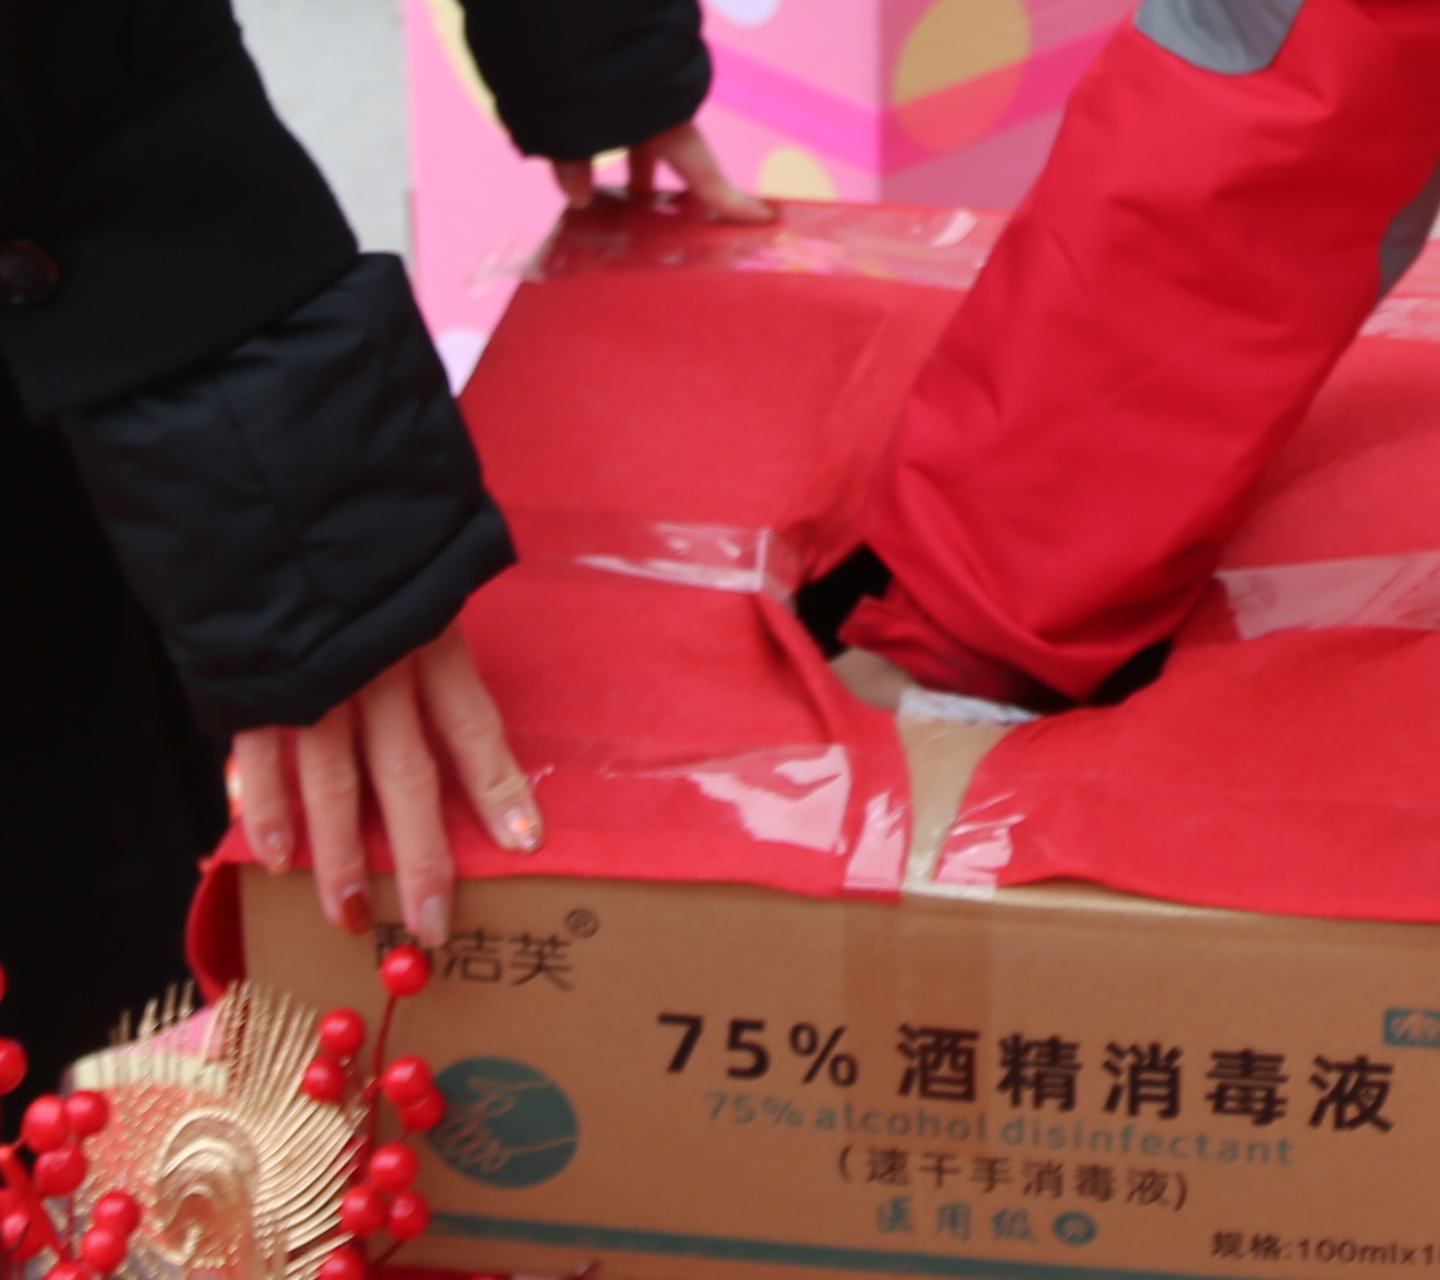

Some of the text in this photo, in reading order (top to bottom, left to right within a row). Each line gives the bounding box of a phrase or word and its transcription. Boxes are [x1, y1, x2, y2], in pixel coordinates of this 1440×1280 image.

[657, 1013, 1396, 1133] 75% 酒精消毒液
[704, 1091, 1295, 1167] 75% alcohol disinfectant
